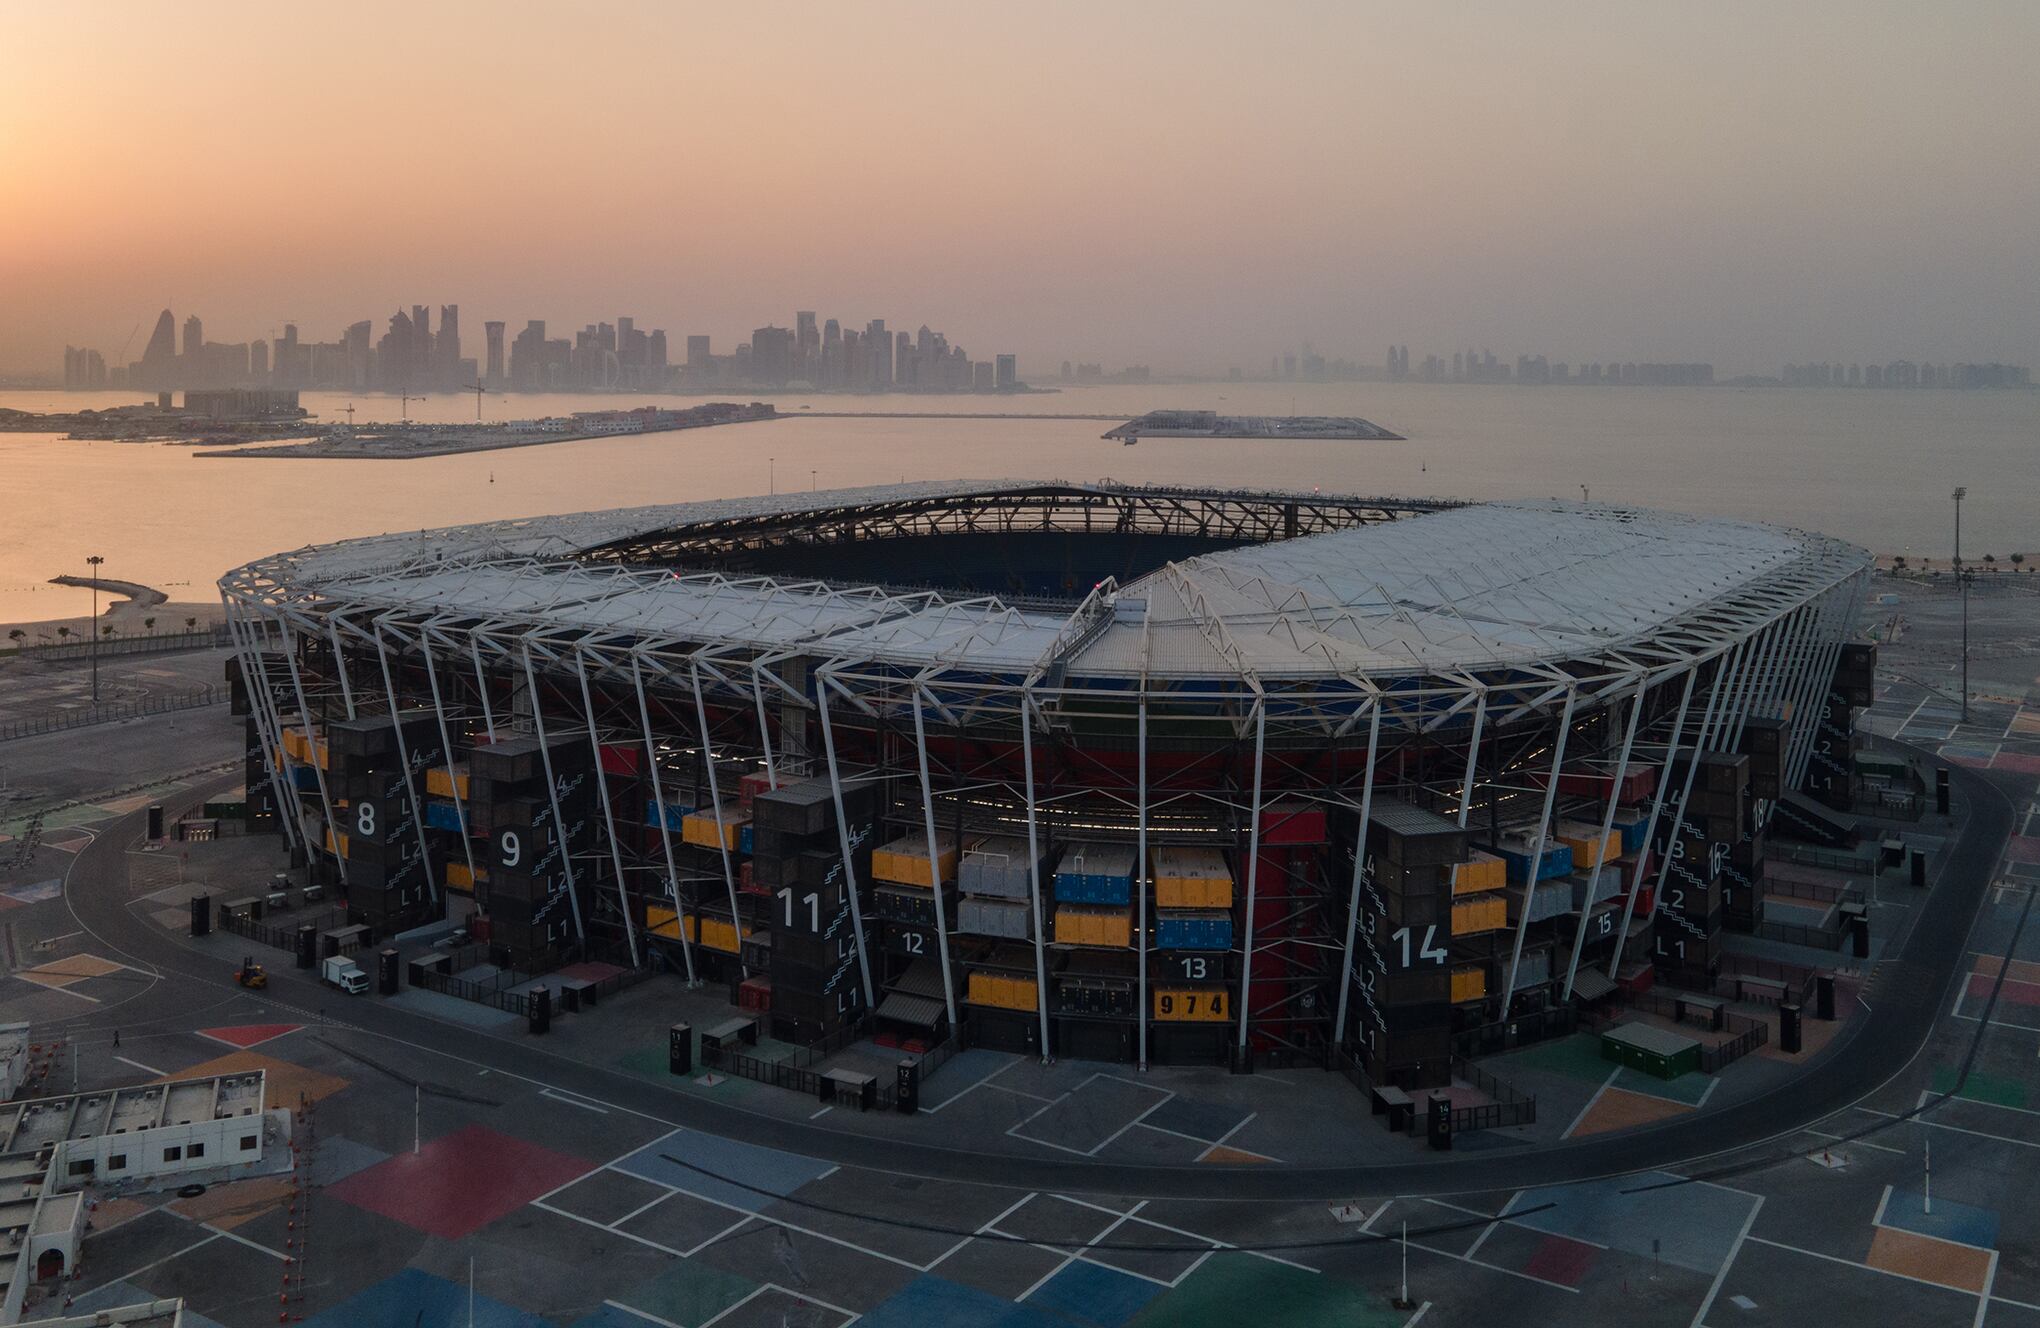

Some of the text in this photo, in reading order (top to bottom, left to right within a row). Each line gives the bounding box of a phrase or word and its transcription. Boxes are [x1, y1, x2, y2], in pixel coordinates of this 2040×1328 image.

[357, 802, 376, 836] 8
[1753, 798, 1764, 832] 18
[501, 831, 521, 867] 9
[1708, 842, 1721, 880] 16
[777, 887, 819, 933] 11
[1598, 913, 1612, 935] 15
[902, 932, 924, 954] 12
[1391, 924, 1448, 968] 14
[1180, 957, 1207, 979] 13
